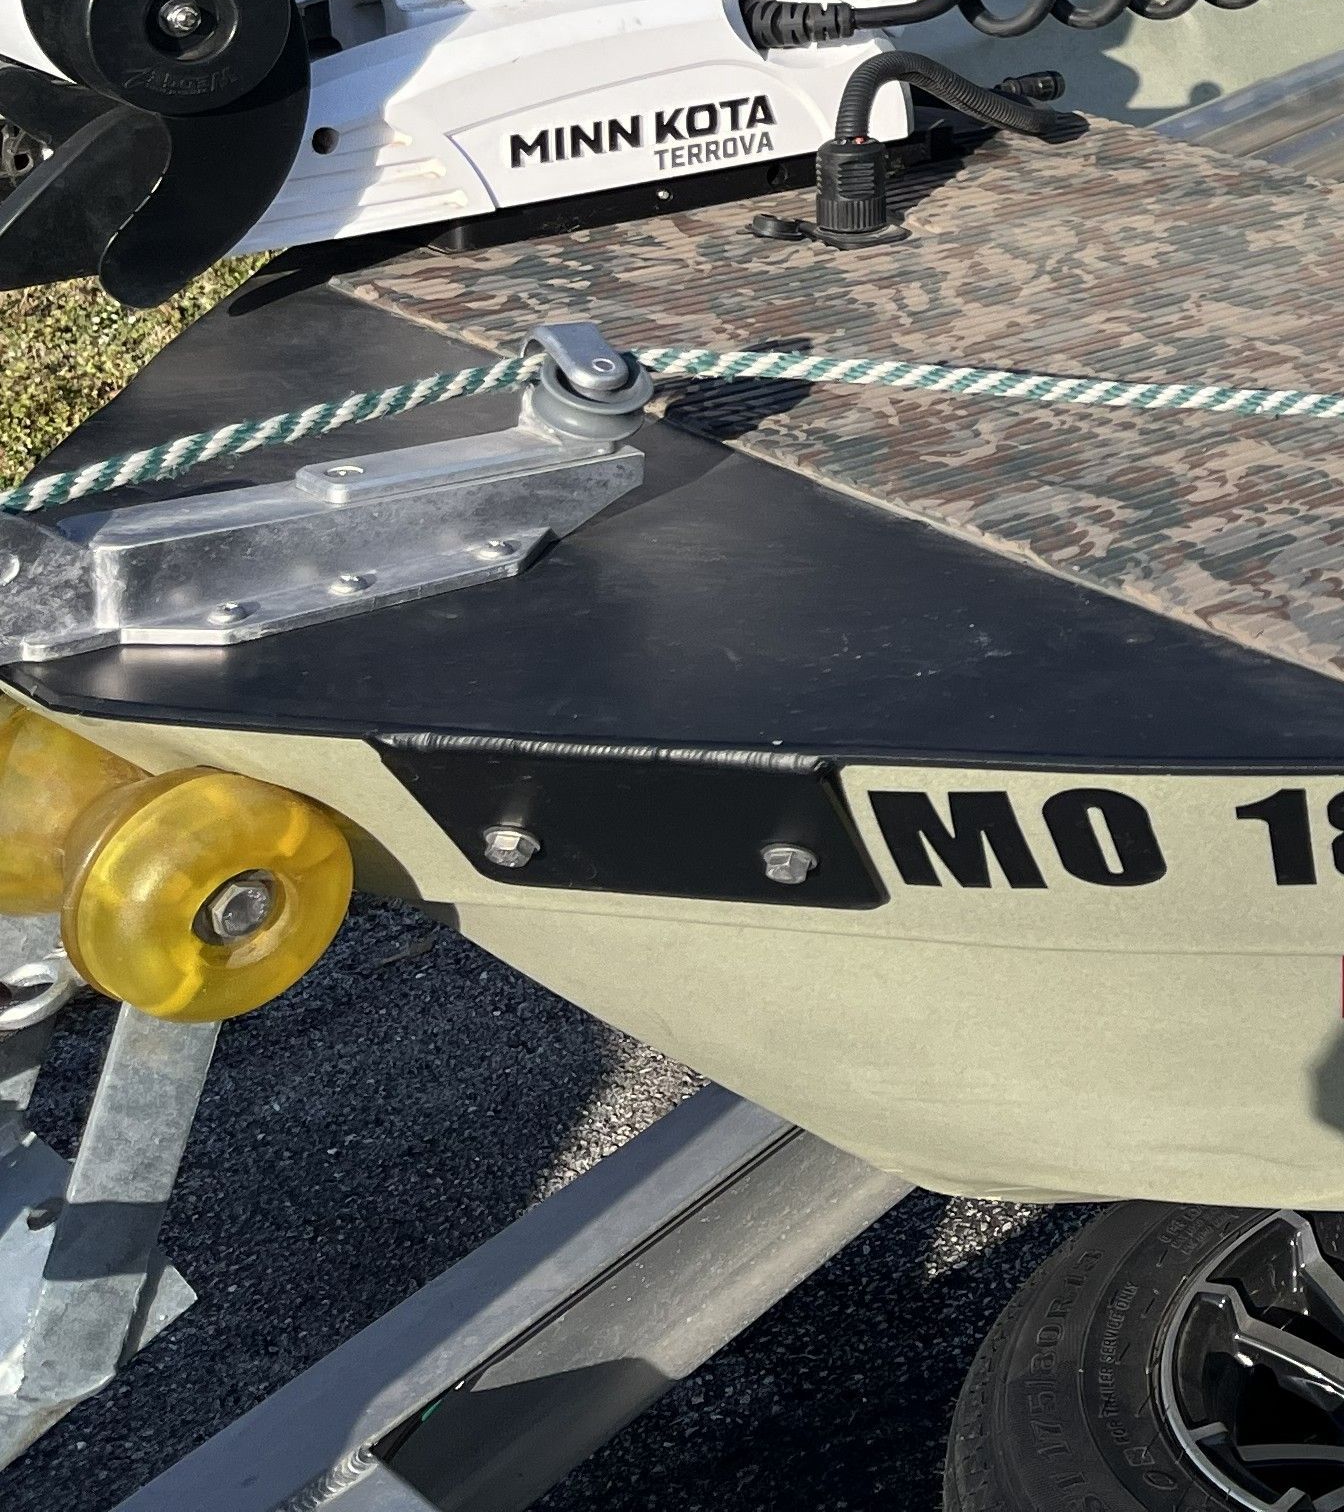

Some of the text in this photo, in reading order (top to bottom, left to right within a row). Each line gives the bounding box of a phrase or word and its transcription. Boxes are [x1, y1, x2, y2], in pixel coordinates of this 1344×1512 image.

[510, 94, 778, 169] MINN KOTA
[654, 131, 774, 171] TERROVA
[868, 788, 1167, 889] MO
[1100, 1310, 1127, 1364] SERVICE
[1098, 1365, 1121, 1419] TRAILER
